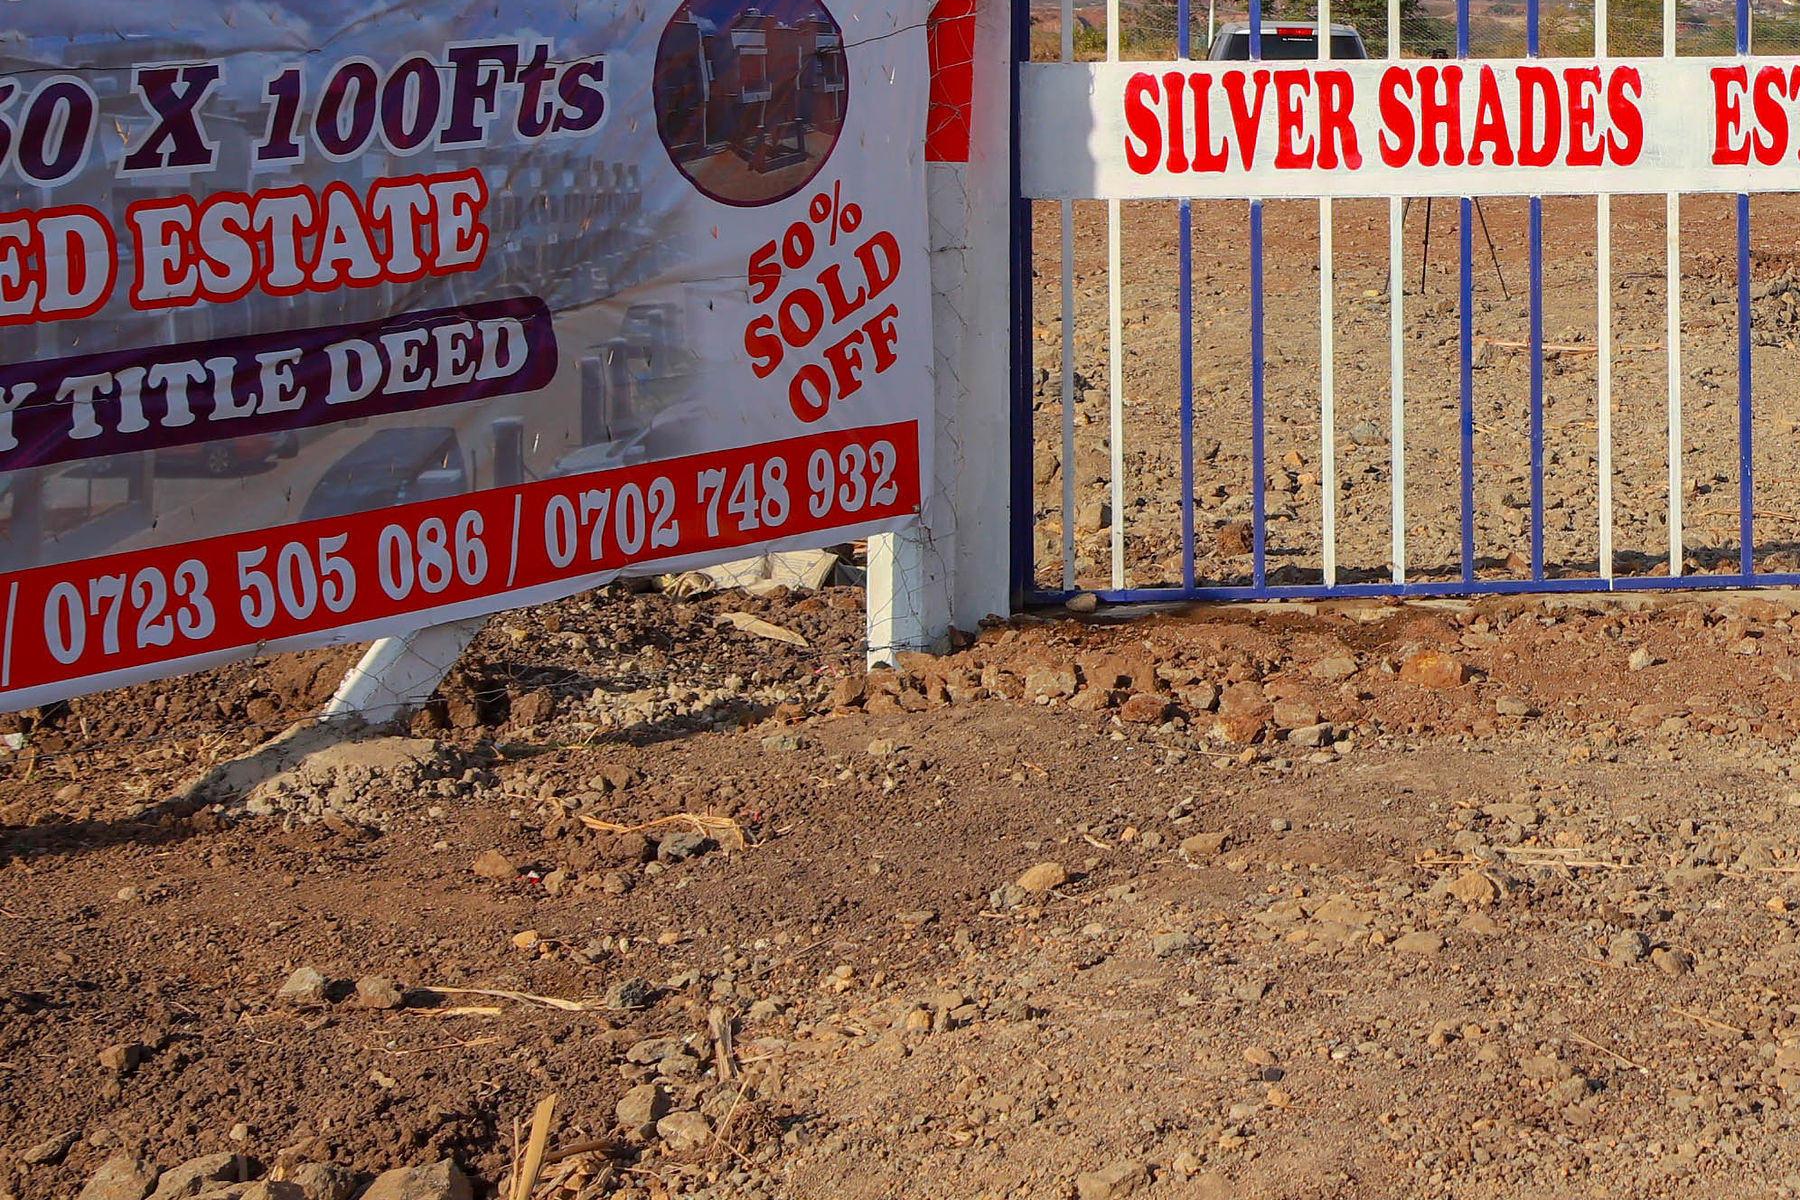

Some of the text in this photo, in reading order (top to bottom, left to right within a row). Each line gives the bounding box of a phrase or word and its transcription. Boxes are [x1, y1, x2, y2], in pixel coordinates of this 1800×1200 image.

[0, 43, 605, 180] 0 X 100Fts
[1124, 69, 1363, 175] SILVER
[1379, 64, 1643, 169] SHADES
[125, 168, 489, 311] ESTATE
[744, 231, 901, 378] SOLD
[748, 180, 862, 303] 50%
[55, 349, 306, 440] TITLE
[324, 318, 528, 404] DEED
[788, 304, 898, 423] OFF
[44, 558, 216, 664] 0723
[237, 532, 357, 628] 505
[378, 509, 488, 600] 086
[544, 477, 679, 568] 0702
[697, 456, 789, 537] 748
[808, 440, 898, 519] 932
